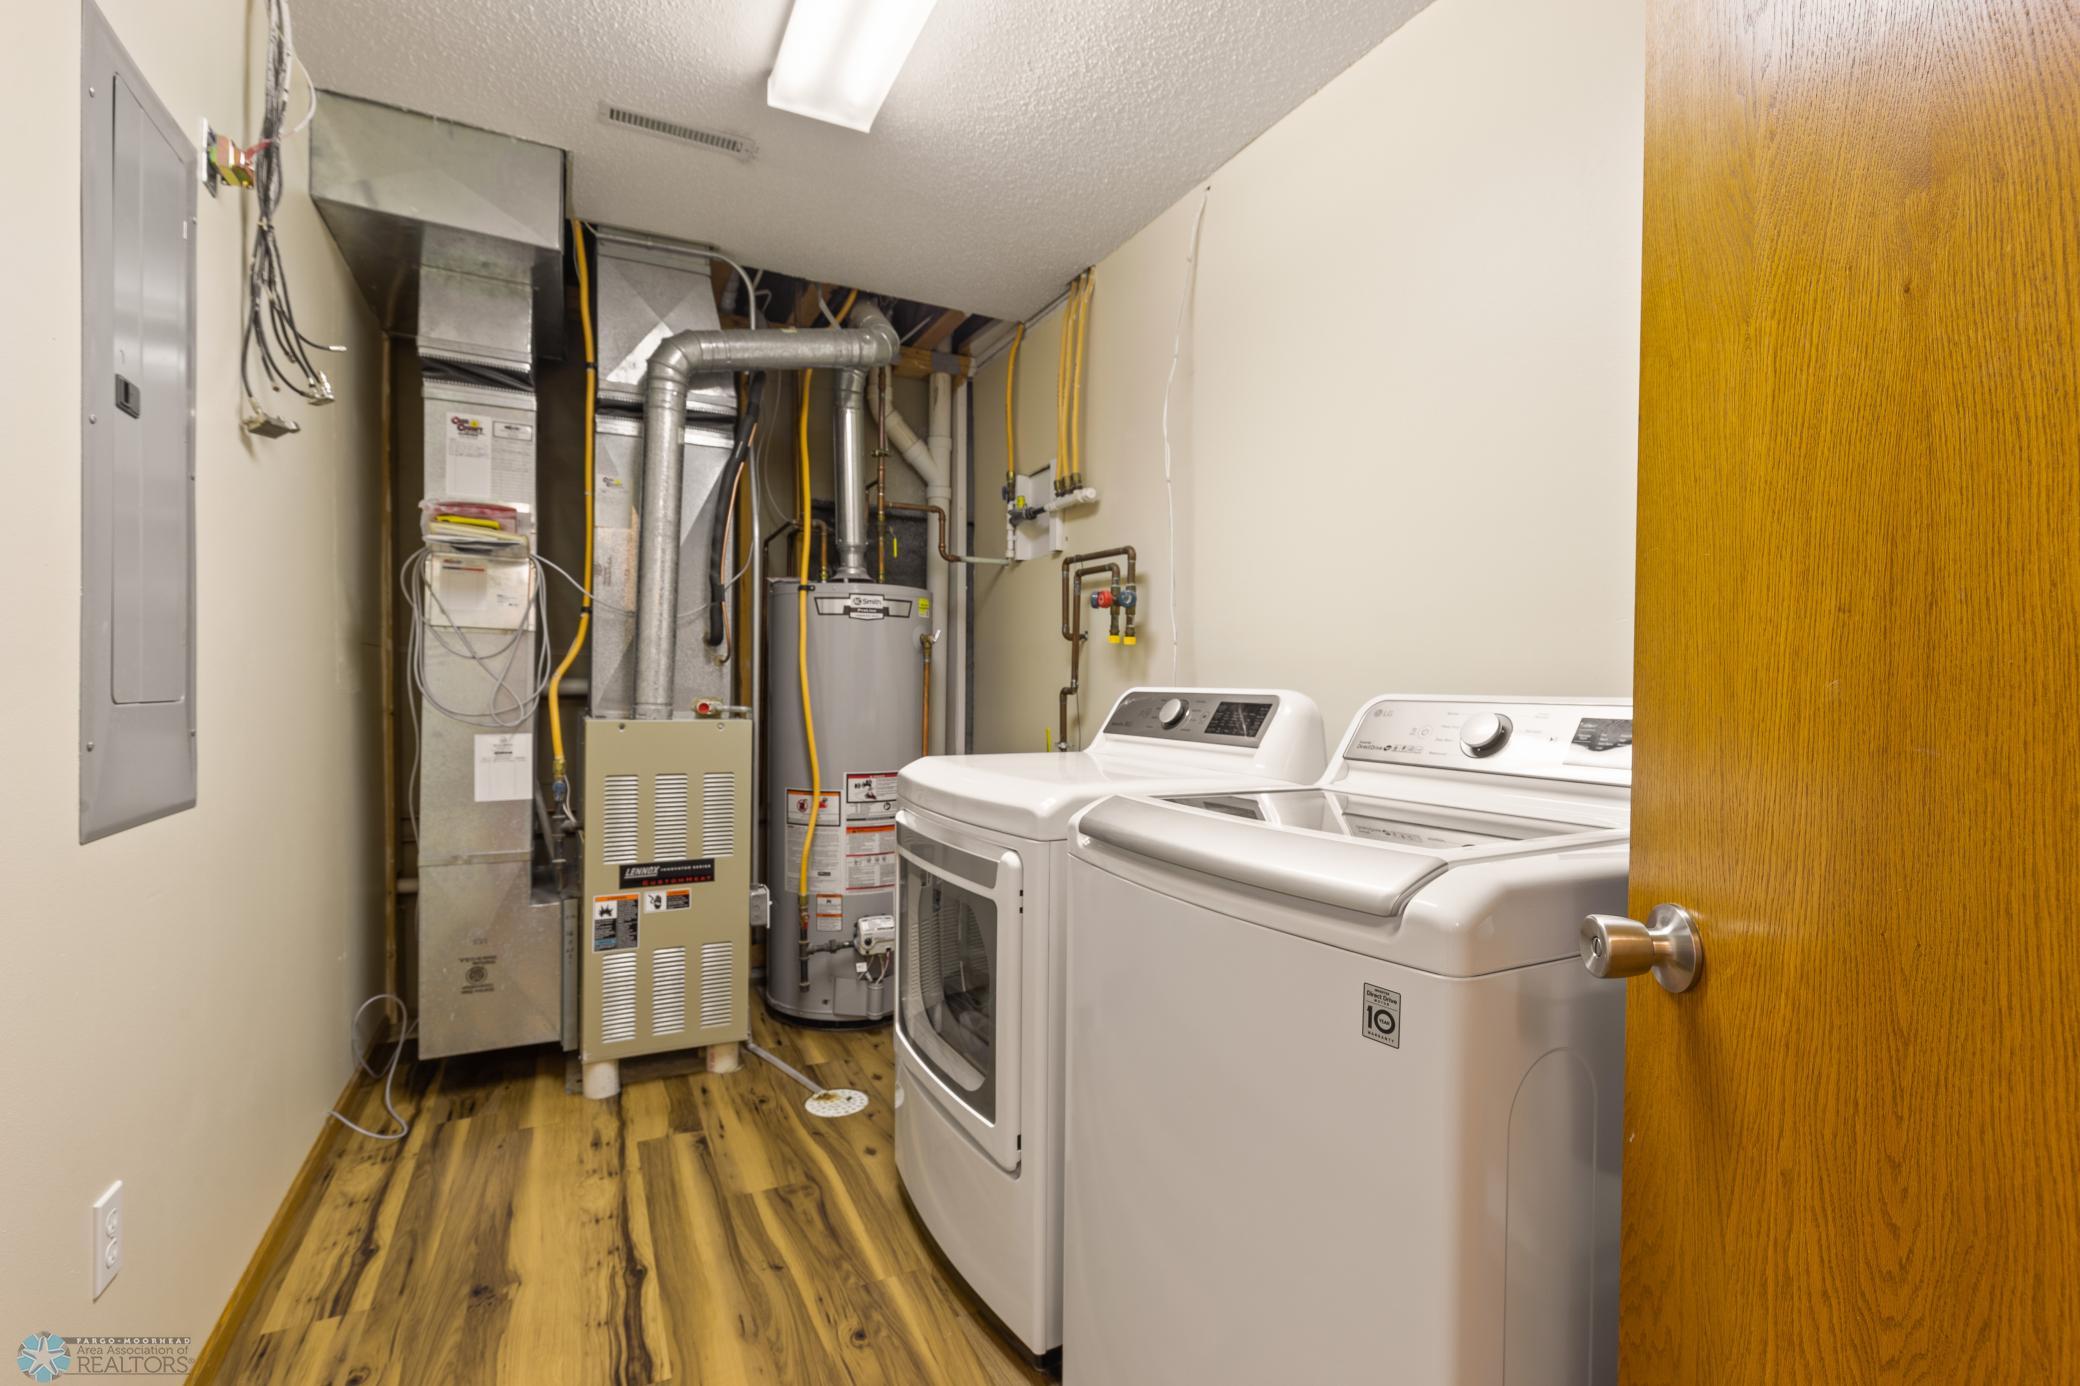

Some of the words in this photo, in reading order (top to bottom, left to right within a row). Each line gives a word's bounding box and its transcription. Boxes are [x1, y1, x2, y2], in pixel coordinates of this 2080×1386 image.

[624, 866, 660, 878] LENNOX
[1366, 990, 1382, 1000] Direct
[1382, 995, 1398, 1005] Drive
[1367, 1005, 1396, 1035] 10
[1379, 1018, 1390, 1026] YEAR
